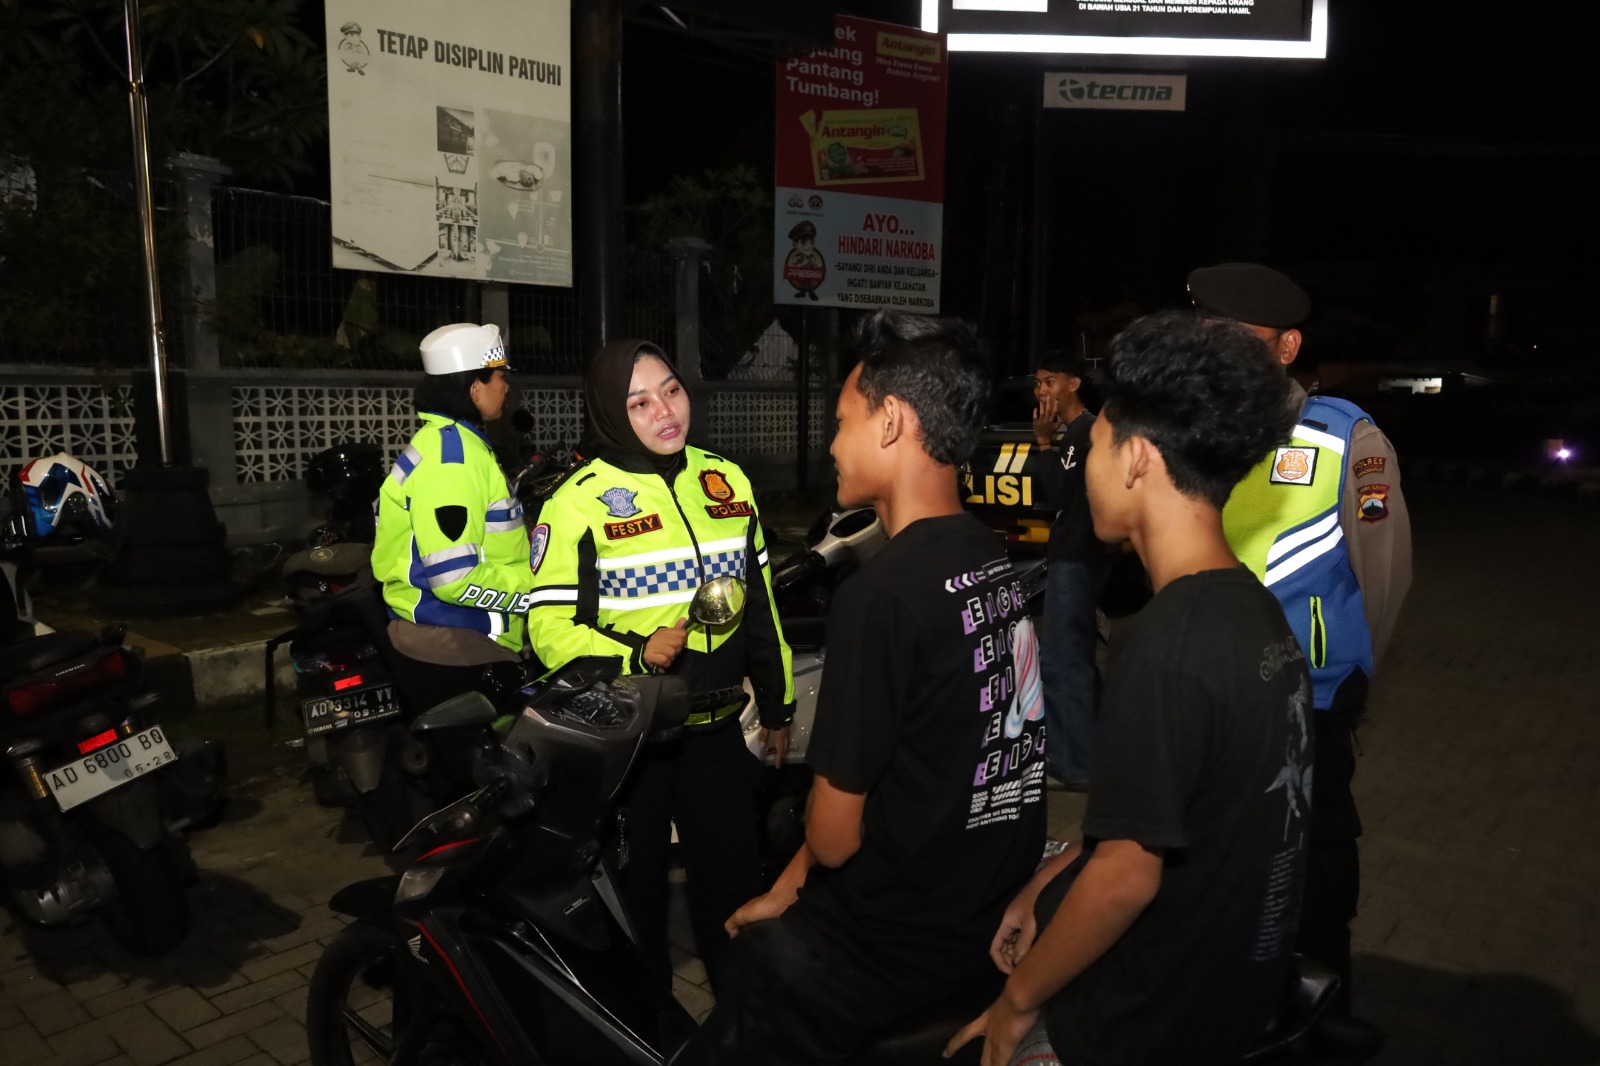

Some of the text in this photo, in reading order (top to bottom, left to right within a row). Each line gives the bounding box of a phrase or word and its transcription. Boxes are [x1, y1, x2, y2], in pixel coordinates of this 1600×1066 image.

[1088, 3, 1113, 11] BAWAH
[1184, 6, 1227, 14] PEREMPUAN
[881, 37, 936, 57] Antangin
[377, 28, 562, 86] TETAP DISIPLIN PATUHI
[786, 58, 864, 86] Pantang
[786, 76, 880, 107] Tumbang!
[1086, 80, 1173, 101] tecma
[821, 124, 885, 140] Antangin
[862, 213, 915, 236] AYO...
[838, 235, 935, 262] HINDARI NARKOBA
[863, 264, 876, 274] DIRI
[877, 265, 893, 274] ANDA
[893, 267, 905, 275] DAN
[869, 280, 893, 289] BANYAK
[893, 281, 926, 292] KEJAHATAN
[837, 293, 935, 307] YANG DISEBABKAN OLEH NARKOBA
[710, 503, 747, 515] POLRI
[611, 517, 653, 536] FESTY
[310, 703, 328, 718] AD
[52, 767, 78, 790] AD
[83, 743, 131, 775] 6800
